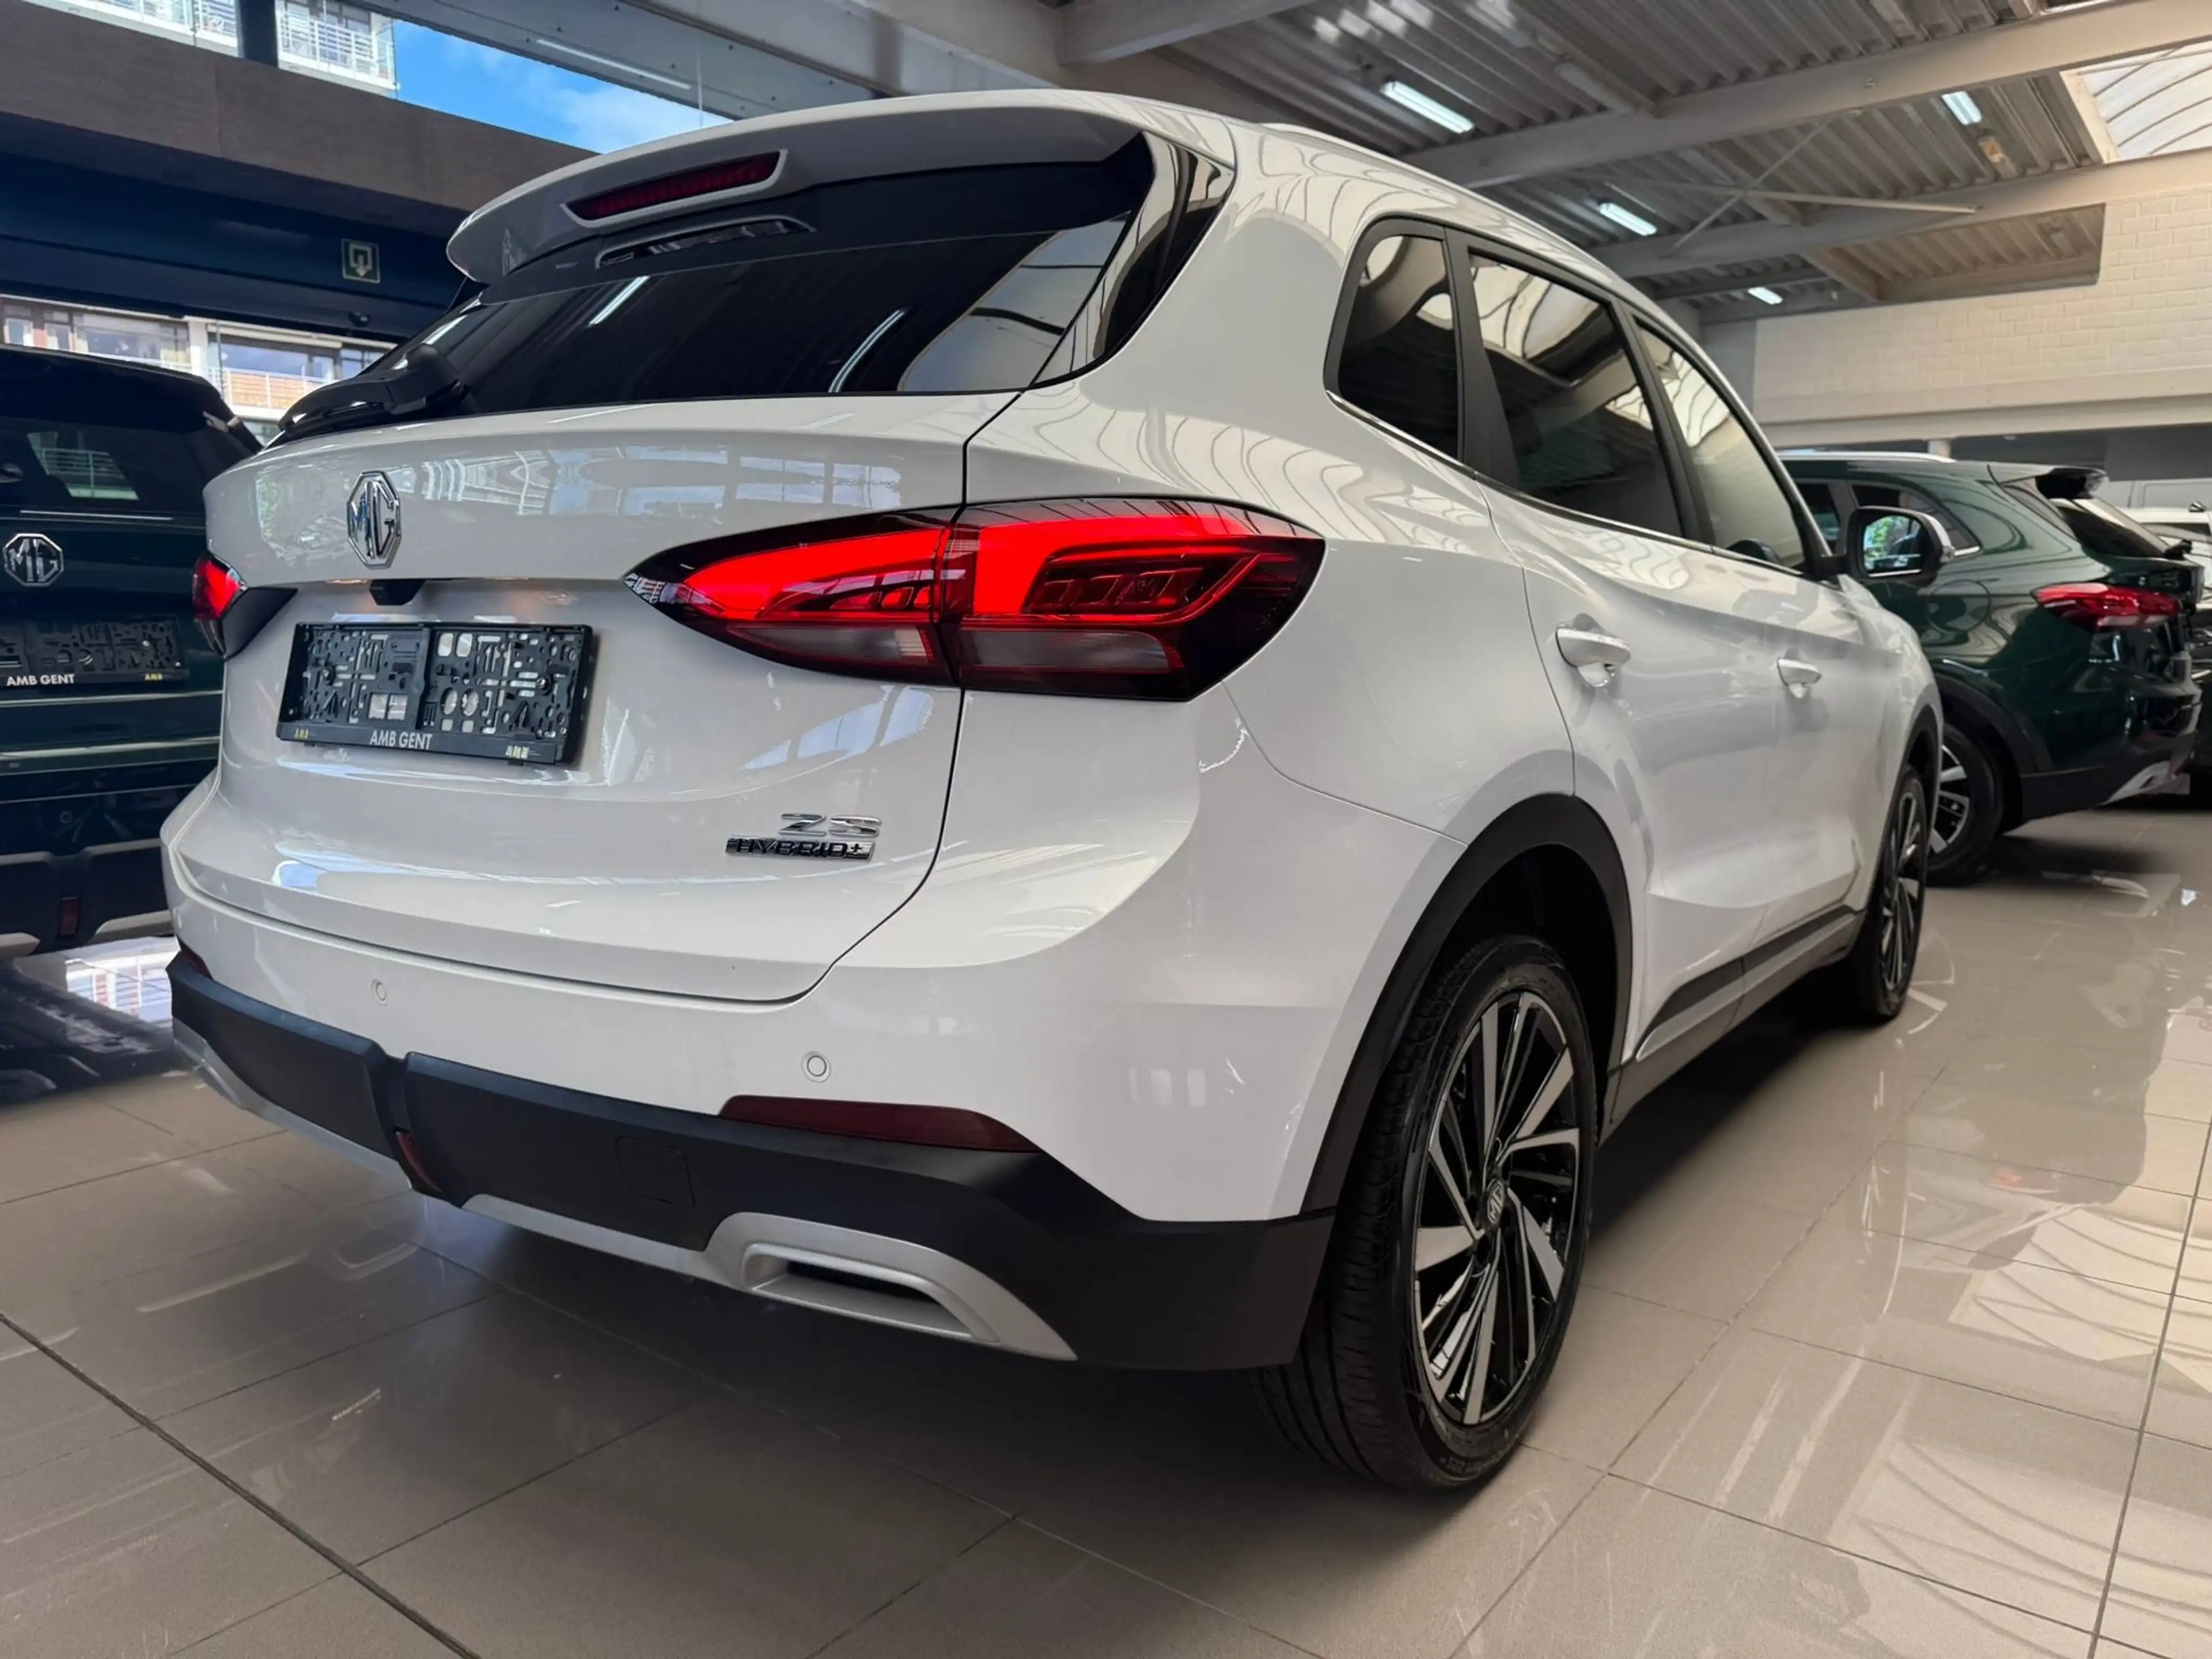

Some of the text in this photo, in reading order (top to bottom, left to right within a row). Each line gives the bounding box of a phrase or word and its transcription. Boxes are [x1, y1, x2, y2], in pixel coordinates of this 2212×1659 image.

[349, 479, 396, 560] MG
[8, 538, 60, 583] MG
[6, 674, 75, 686] AMB GENT
[369, 729, 433, 749] AMB GENT
[778, 813, 882, 837] ZS
[734, 837, 864, 858] HYBRID+
